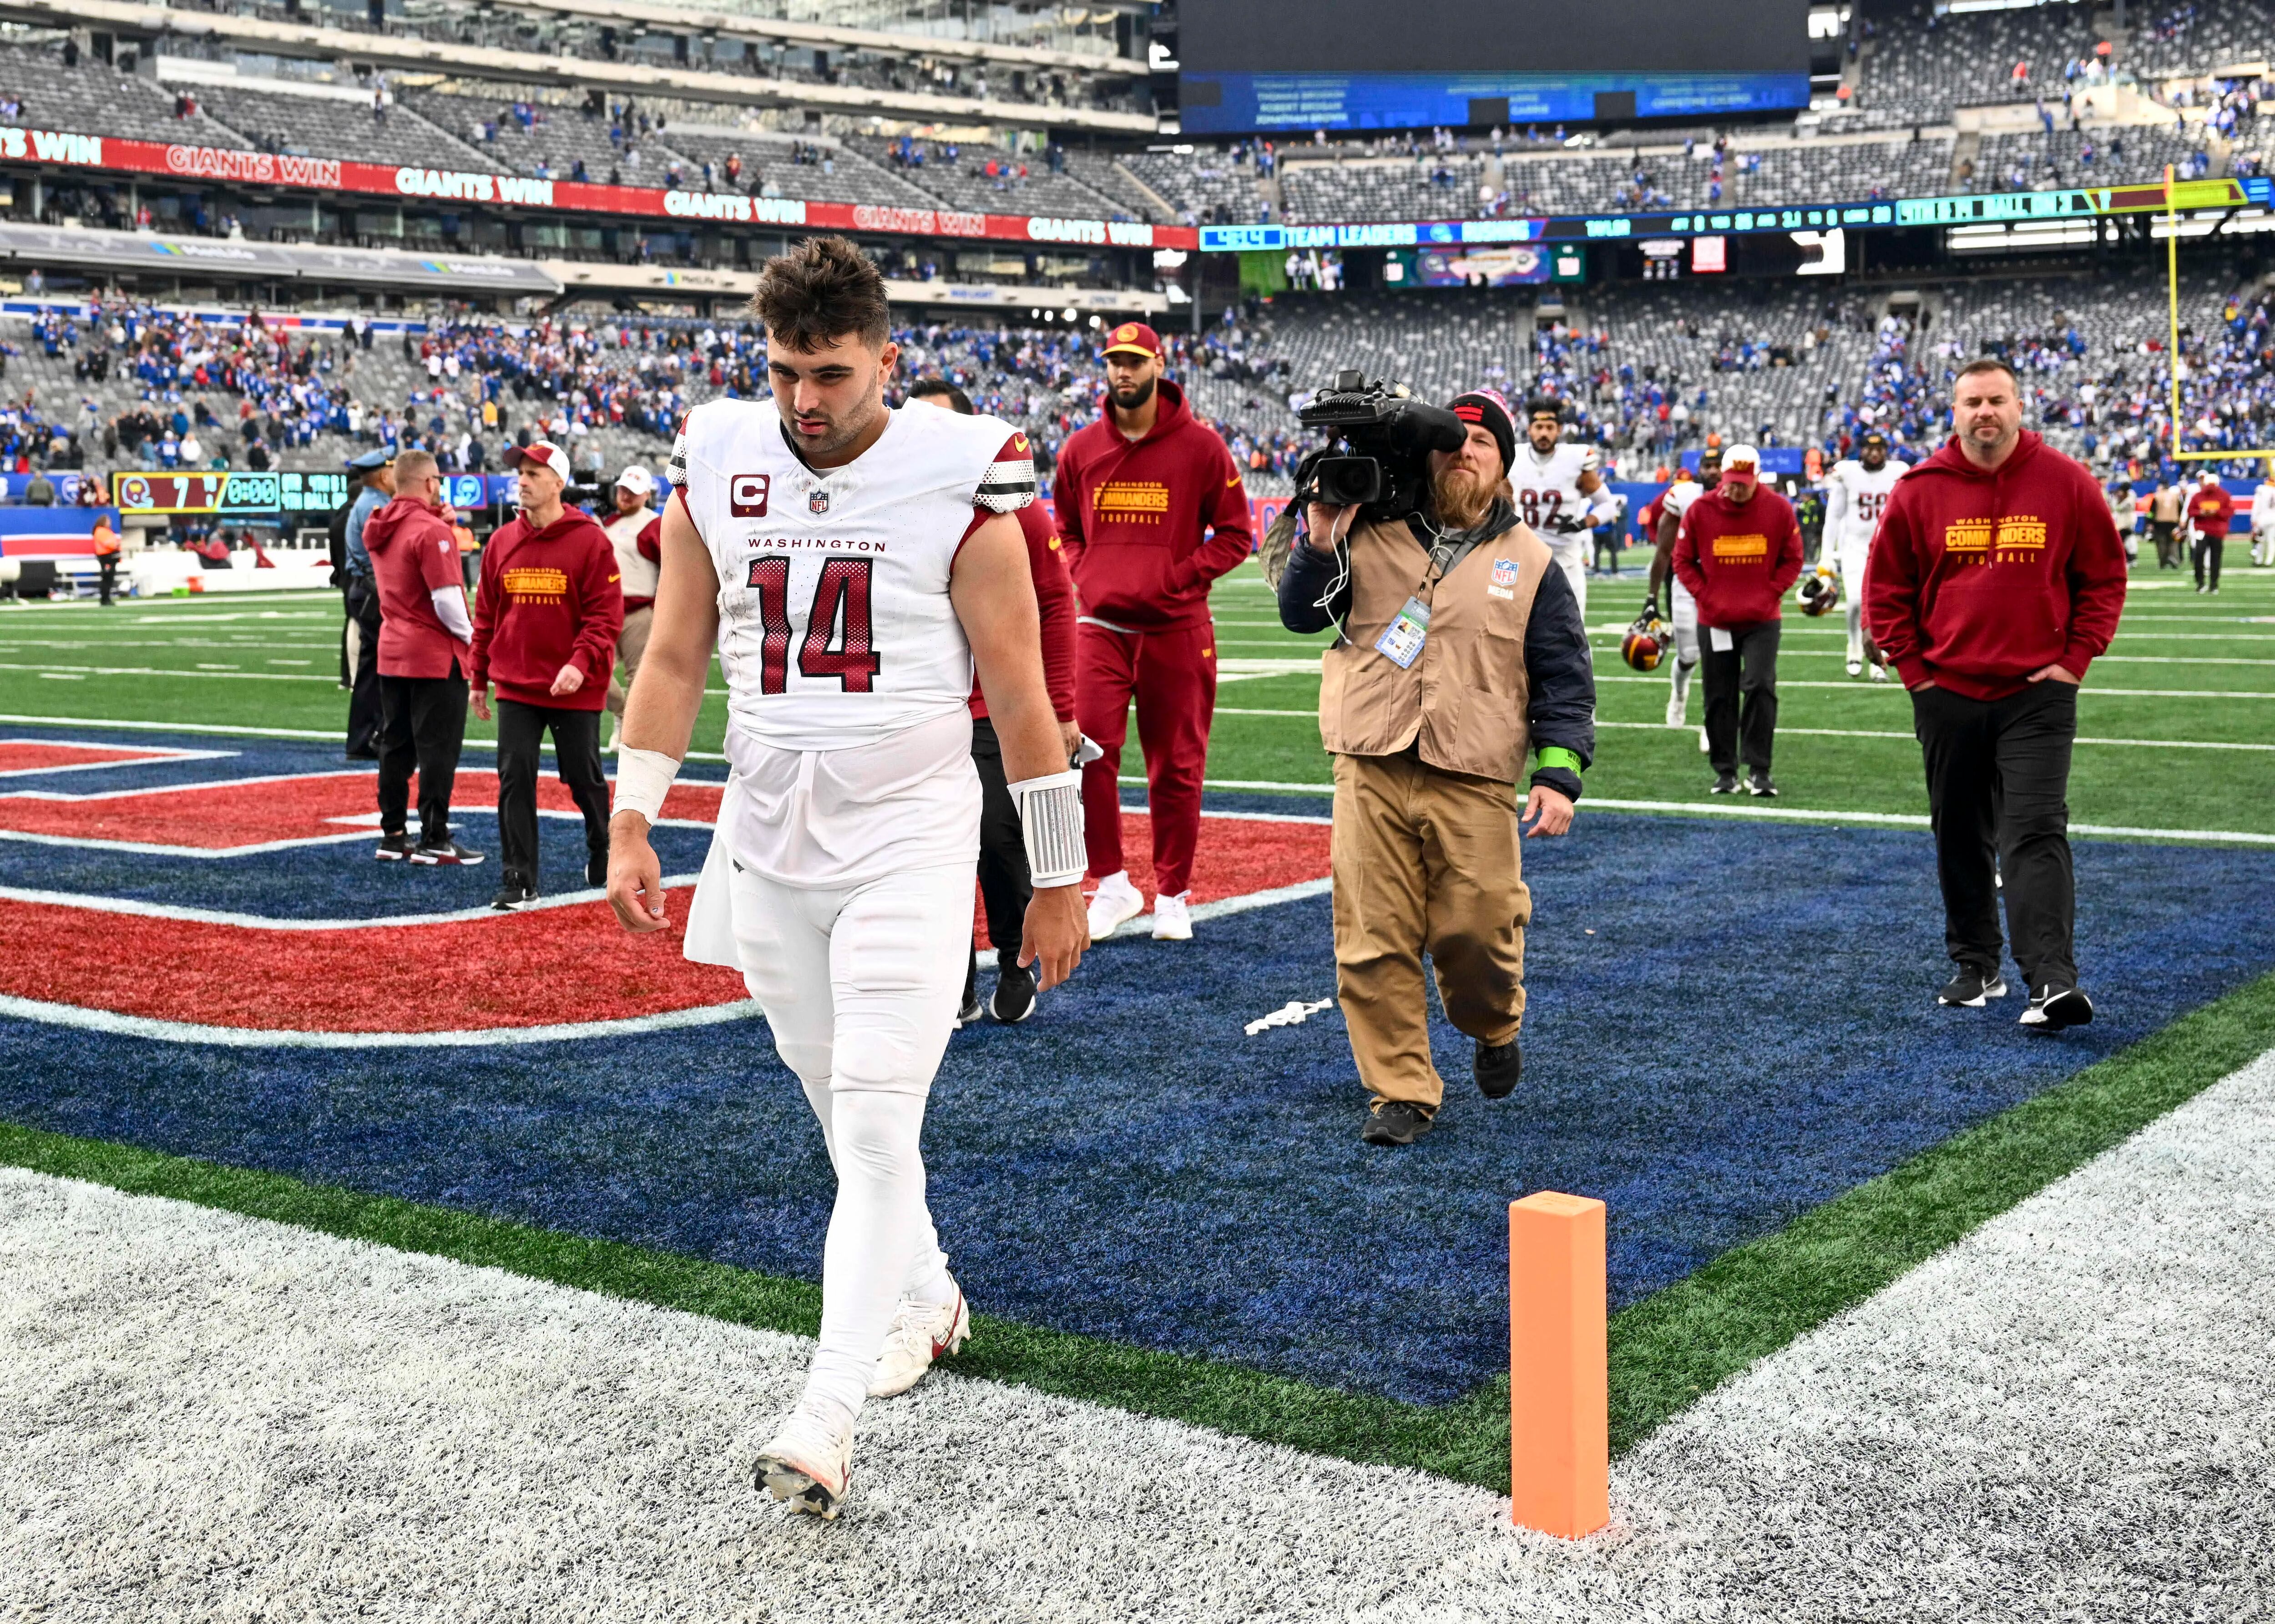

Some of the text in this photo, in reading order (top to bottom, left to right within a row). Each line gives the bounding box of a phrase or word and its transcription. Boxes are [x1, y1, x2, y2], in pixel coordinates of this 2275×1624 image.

[32, 131, 101, 165] WIN
[166, 144, 341, 186] GIANTS WIN
[395, 167, 553, 205] GIANTS WIN
[663, 190, 806, 224] GIANTS WIN
[853, 204, 986, 235] GIANTS WIN
[1027, 217, 1153, 246] GIANTS WIN
[1286, 226, 1335, 247] TEAM
[1338, 224, 1417, 246] LEADERS
[173, 477, 188, 509] 7
[228, 478, 275, 504] 0:00
[733, 477, 766, 506] C
[1093, 491, 1169, 507] COMMANDERS
[812, 501, 826, 511] NFL
[1101, 513, 1159, 525] FOOTBALL
[1520, 488, 1562, 529] 82
[1956, 515, 2038, 526] WASHNGTON
[748, 539, 885, 551] WASHINGTON
[1957, 552, 2035, 565] FOOBALL
[1494, 569, 1513, 582] NFL
[1487, 585, 1514, 600] MEDIA
[746, 555, 881, 695] 14
